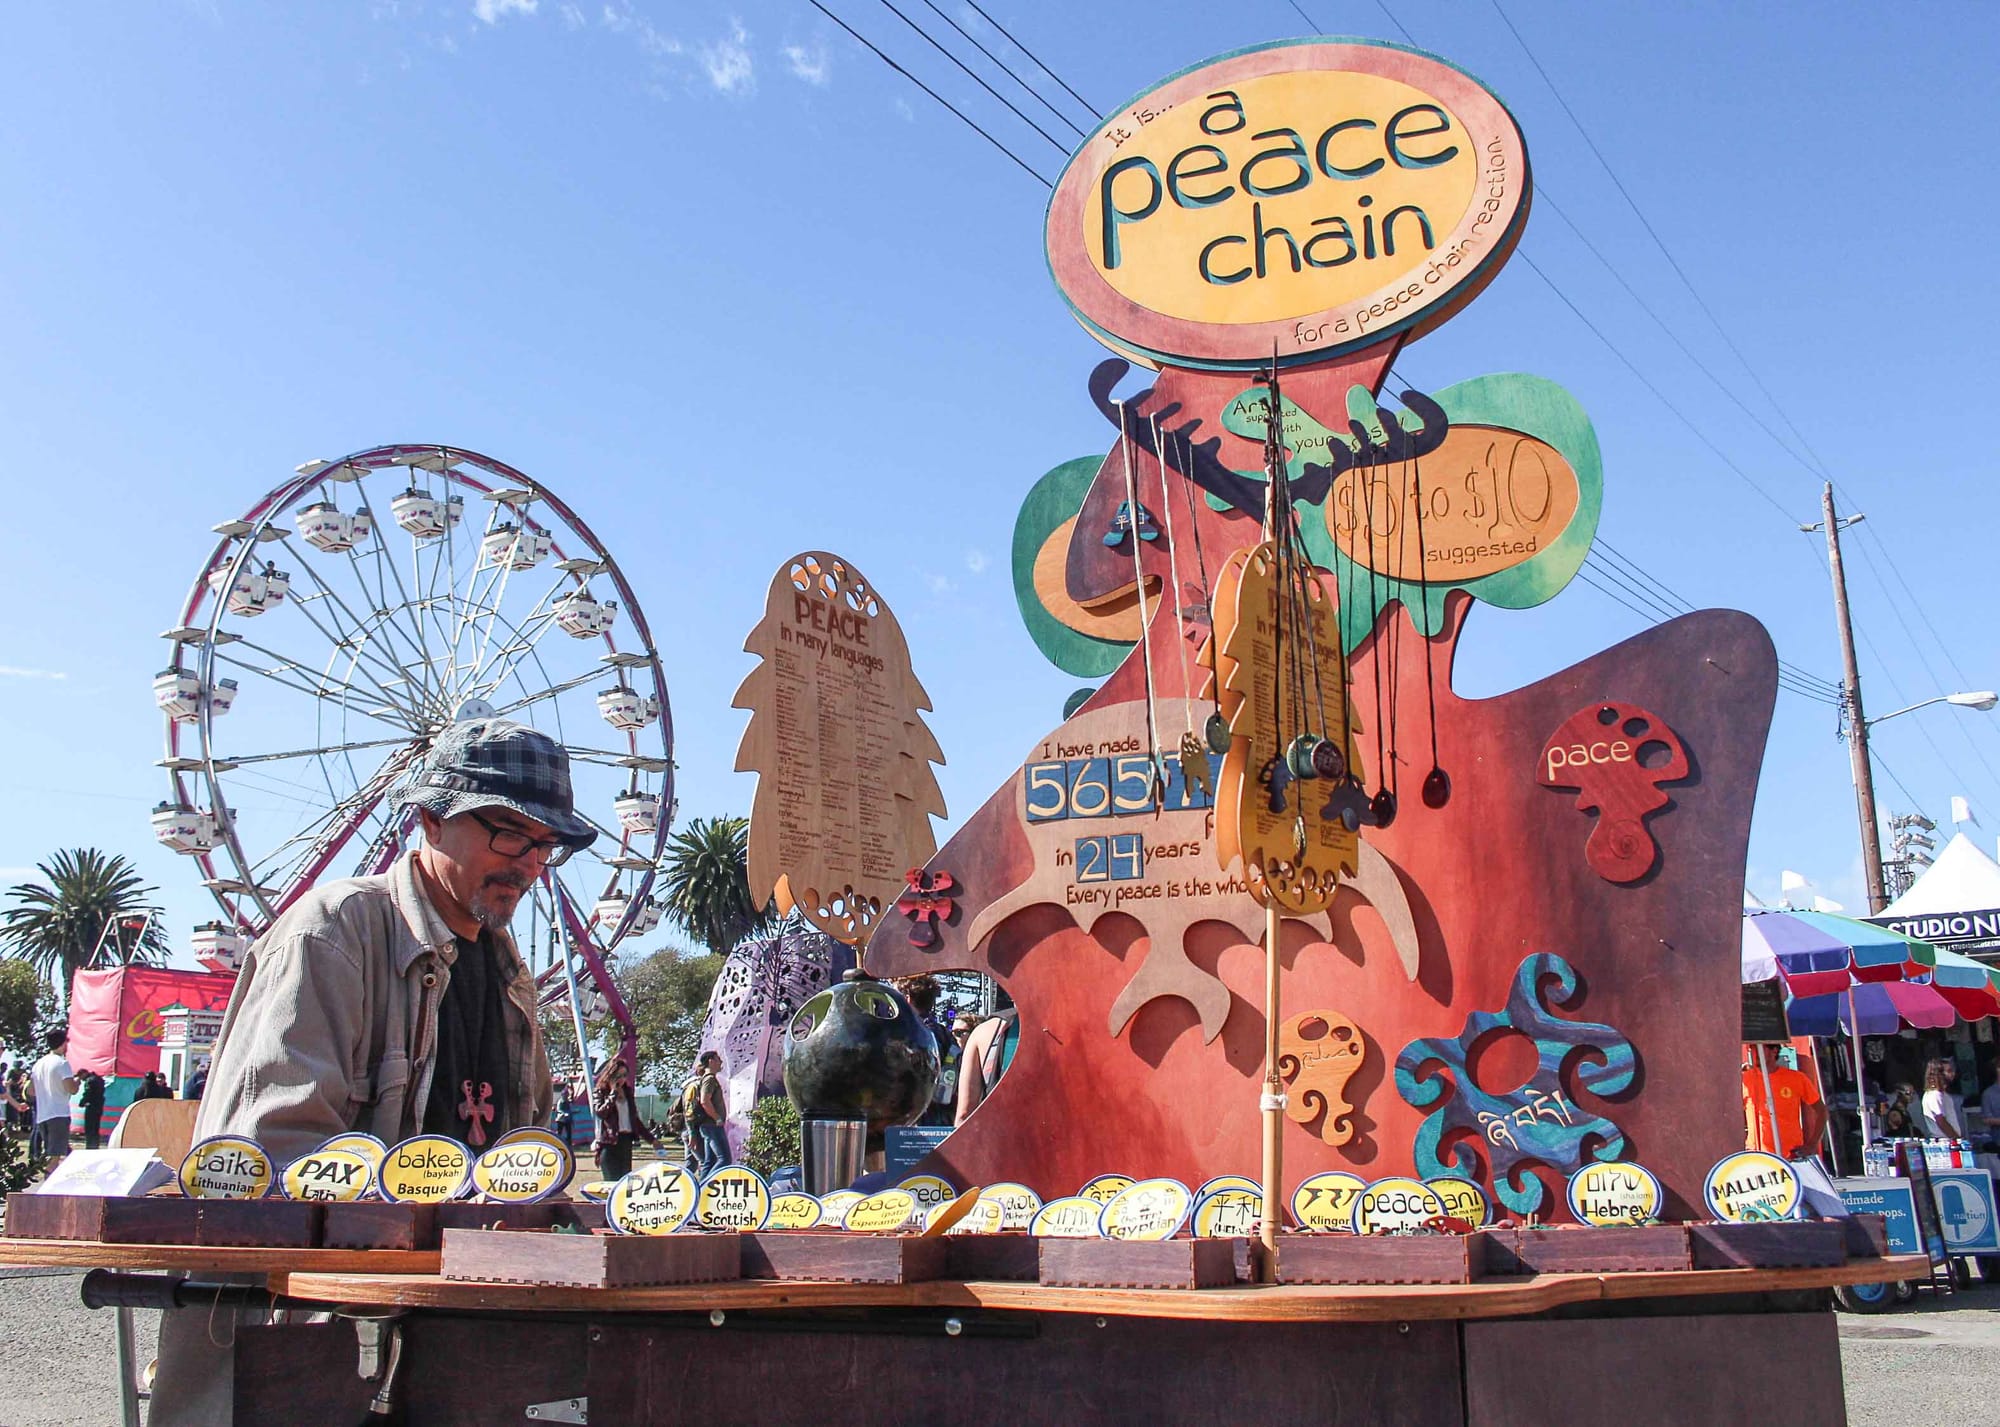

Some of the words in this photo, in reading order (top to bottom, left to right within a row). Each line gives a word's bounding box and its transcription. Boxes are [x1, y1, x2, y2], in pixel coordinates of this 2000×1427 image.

[1105, 127, 1132, 149] It
[1132, 104, 1173, 127] is...
[1200, 90, 1247, 135] a
[1101, 103, 1459, 270] peace
[1200, 194, 1435, 285] chain
[1294, 321, 1330, 345] for
[1334, 318, 1351, 334] a
[1356, 282, 1424, 334] peace
[1424, 239, 1476, 285] chain
[1471, 135, 1506, 237] reaction.
[1463, 438, 1553, 540] $10
[1426, 536, 1537, 565] suggested
[794, 591, 869, 647] PEACE
[780, 621, 792, 643] in
[796, 631, 828, 660] many
[830, 634, 884, 675] languages
[1043, 743, 1051, 760] I
[1057, 743, 1095, 758] have
[1099, 737, 1140, 754] made
[1547, 740, 1632, 781] pace
[1056, 849, 1073, 867] in
[1080, 834, 1139, 881] 24
[1143, 839, 1201, 865] years
[1067, 884, 1111, 906] Every
[1115, 883, 1161, 908] peace
[1166, 880, 1181, 897] is
[1184, 878, 1211, 897] the
[1887, 917, 1970, 939] STUDIO
[1974, 913, 2000, 937] N
[195, 1149, 266, 1178] taika
[298, 1159, 364, 1185] PAX
[398, 1147, 464, 1169] bakea
[481, 1147, 558, 1169] uxolo
[191, 1176, 255, 1194] Lithuanian
[397, 1183, 448, 1198] Basque
[486, 1178, 539, 1193] Xhosa
[626, 1169, 682, 1198] PAZ
[707, 1178, 758, 1198] SITH
[1587, 1168, 1643, 1192] שלום
[1712, 1168, 1792, 1200] MALUHIA
[627, 1197, 677, 1217] Spanish,
[703, 1211, 758, 1227] Scottish
[716, 1199, 747, 1213] (shee)
[852, 1196, 911, 1218] paco
[1211, 1194, 1263, 1225] 平和
[1362, 1193, 1438, 1226] peace
[1581, 1200, 1652, 1217] Hebrew
[850, 1218, 900, 1229] Esperanto
